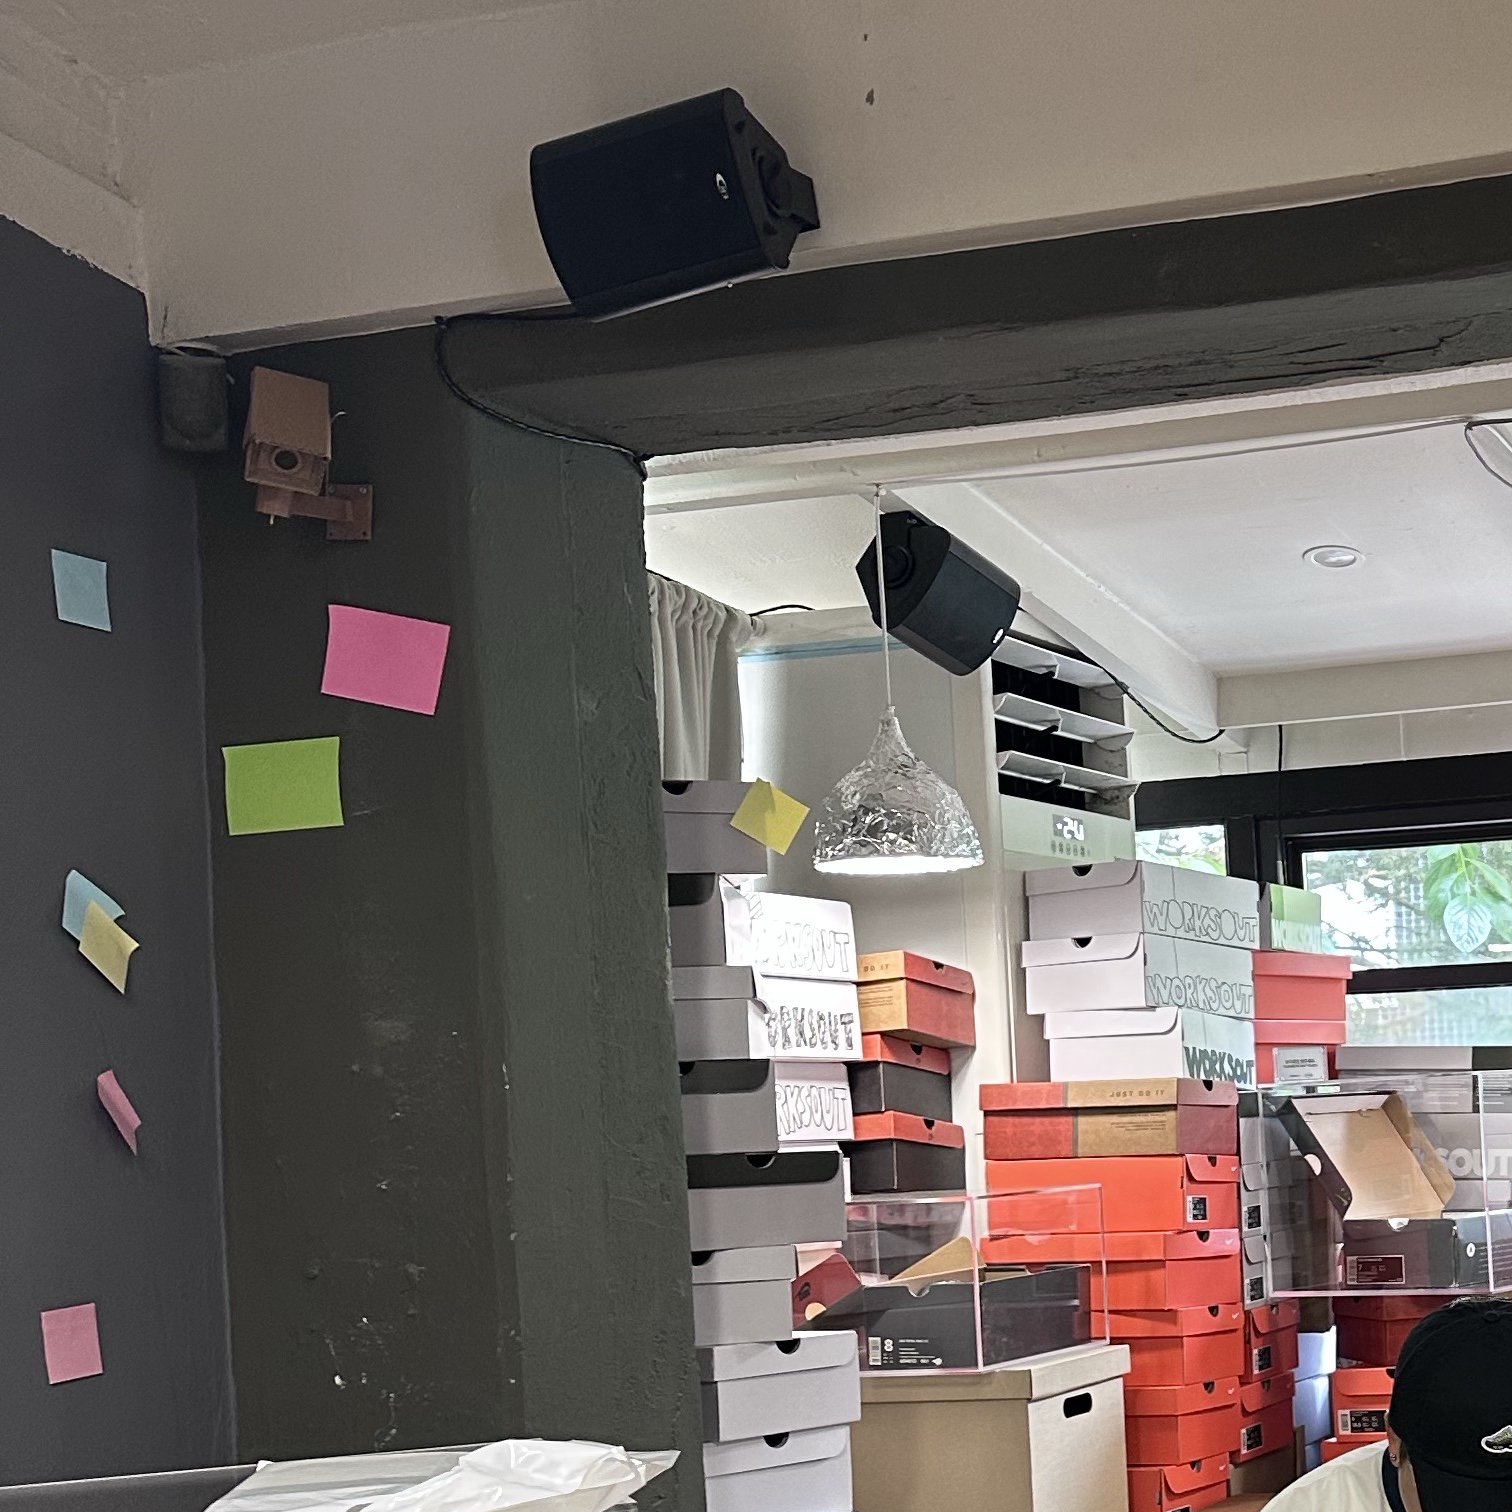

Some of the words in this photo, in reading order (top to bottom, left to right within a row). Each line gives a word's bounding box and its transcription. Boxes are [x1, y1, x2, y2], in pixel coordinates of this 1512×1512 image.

[1143, 899, 1258, 943] WORKSOUT
[1146, 973, 1254, 1015] WORKSOUT
[1183, 1046, 1255, 1085] WORKSOUT
[883, 1339, 894, 1352] 8
